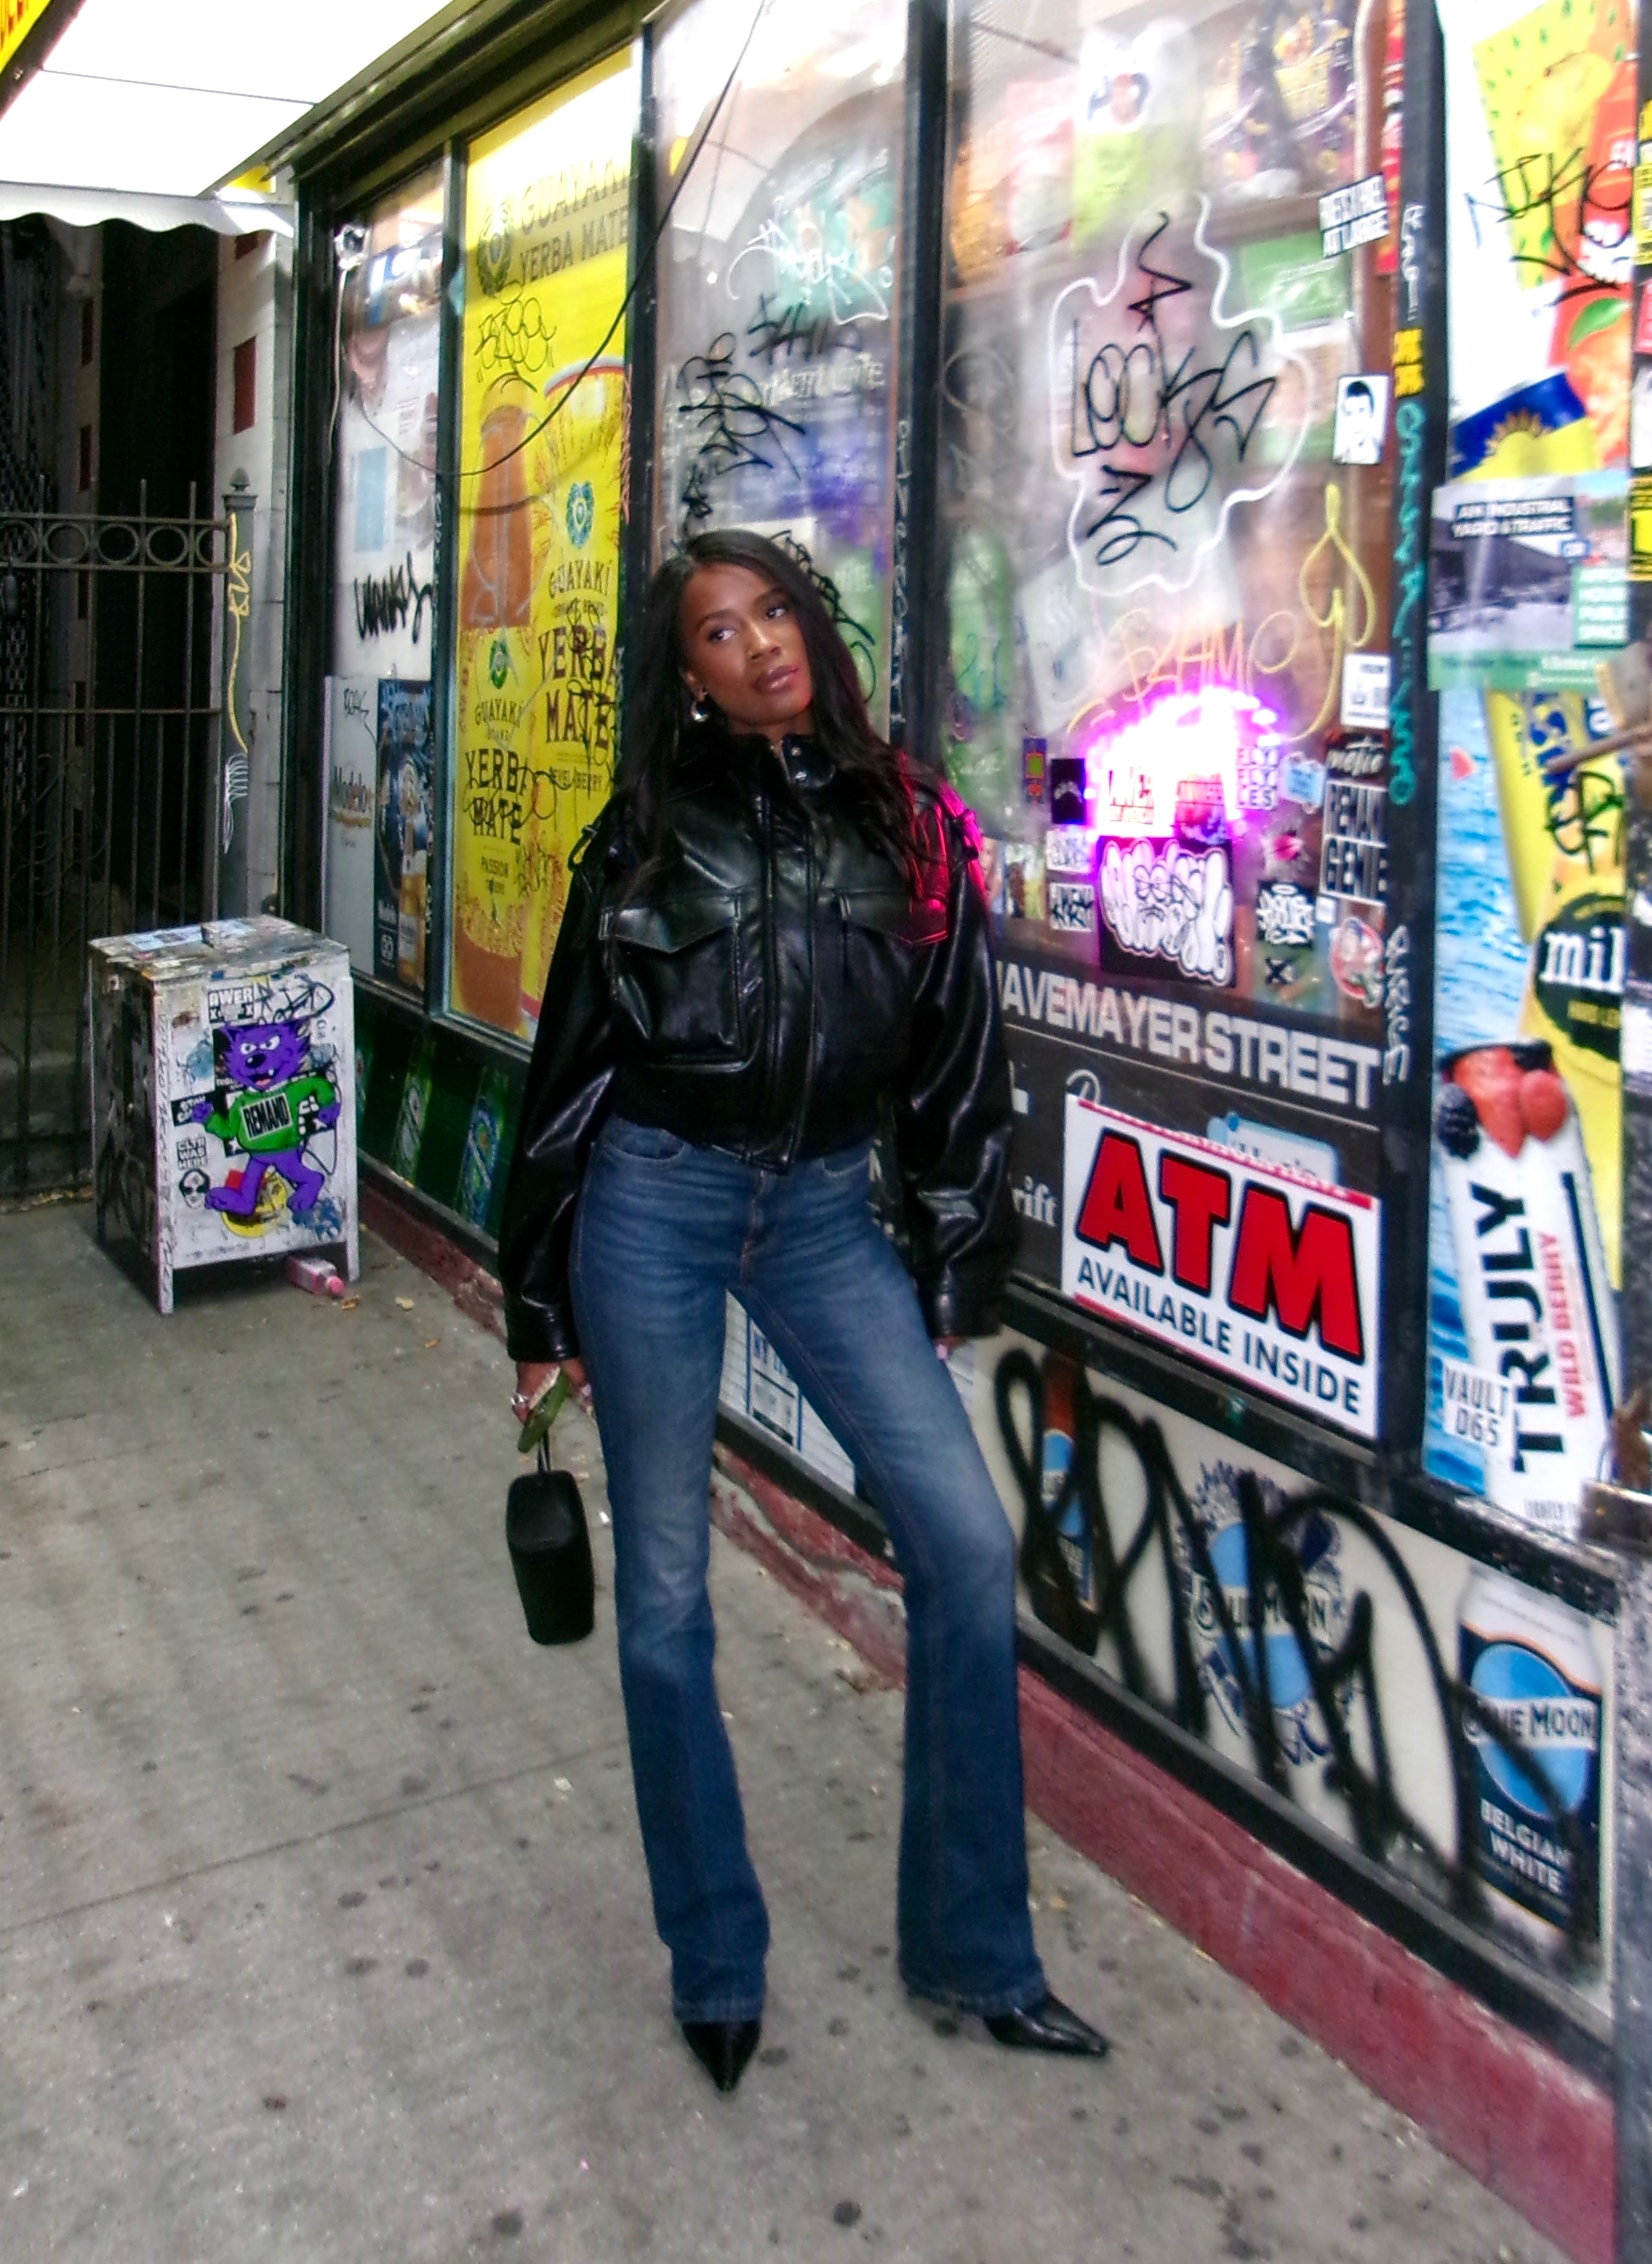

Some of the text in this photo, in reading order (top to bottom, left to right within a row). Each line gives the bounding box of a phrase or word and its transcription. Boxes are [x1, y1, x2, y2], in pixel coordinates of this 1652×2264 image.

[520, 203, 628, 285] YERBA MATE
[546, 689, 610, 749] MATE
[473, 797, 522, 846] MATE
[996, 959, 1382, 1110] AVEMAYER STREET
[1074, 1127, 1367, 1366] ATM
[1077, 1256, 1361, 1415] AVAILABLE INSIDE
[1469, 1181, 1565, 1473] TRULY
[1537, 1232, 1586, 1418] WILD BERRY
[1445, 1367, 1509, 1418] VAULT
[1530, 1701, 1593, 1739] MOON
[1480, 1798, 1573, 1866] BELGIAN
[1490, 1829, 1562, 1894] WHITE
